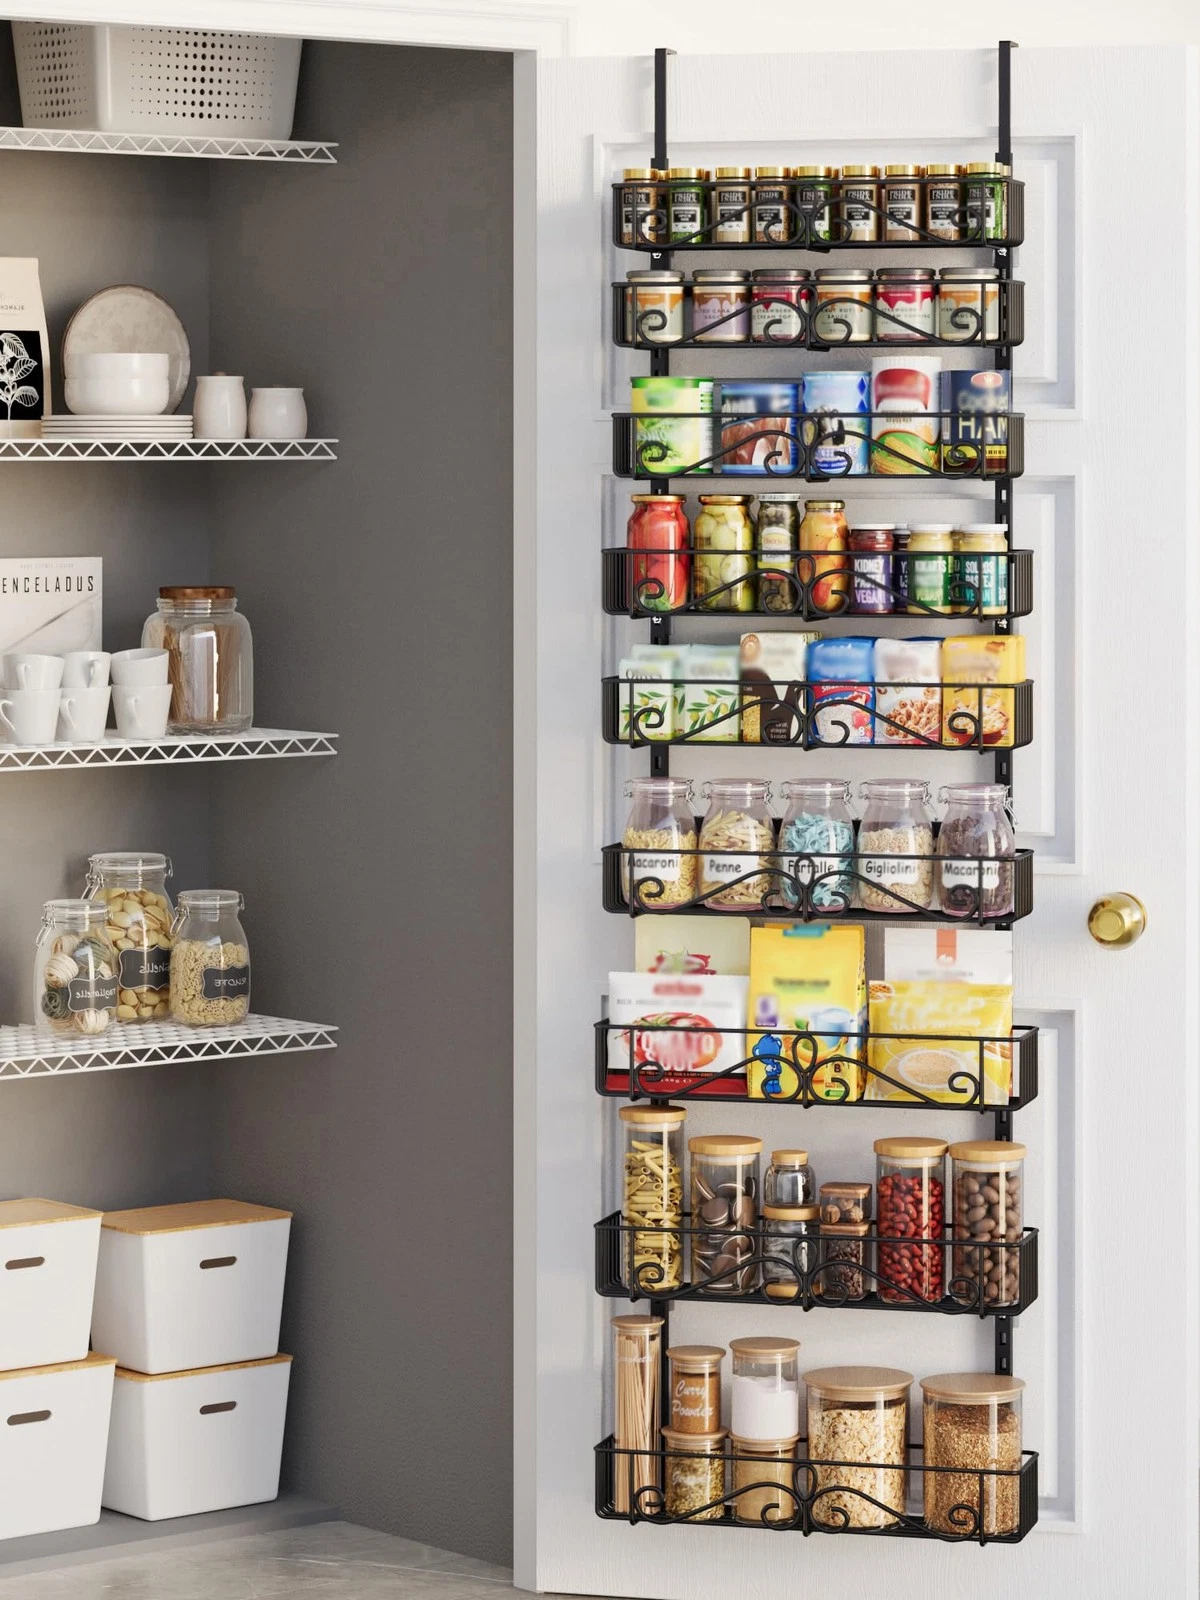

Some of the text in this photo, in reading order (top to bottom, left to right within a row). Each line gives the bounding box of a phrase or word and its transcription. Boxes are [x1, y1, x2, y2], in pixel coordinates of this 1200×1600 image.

[2, 575, 94, 594] ENCELADUS
[709, 859, 742, 873] Penne
[865, 860, 916, 878] Gigliolini
[675, 1380, 707, 1398] Curry
